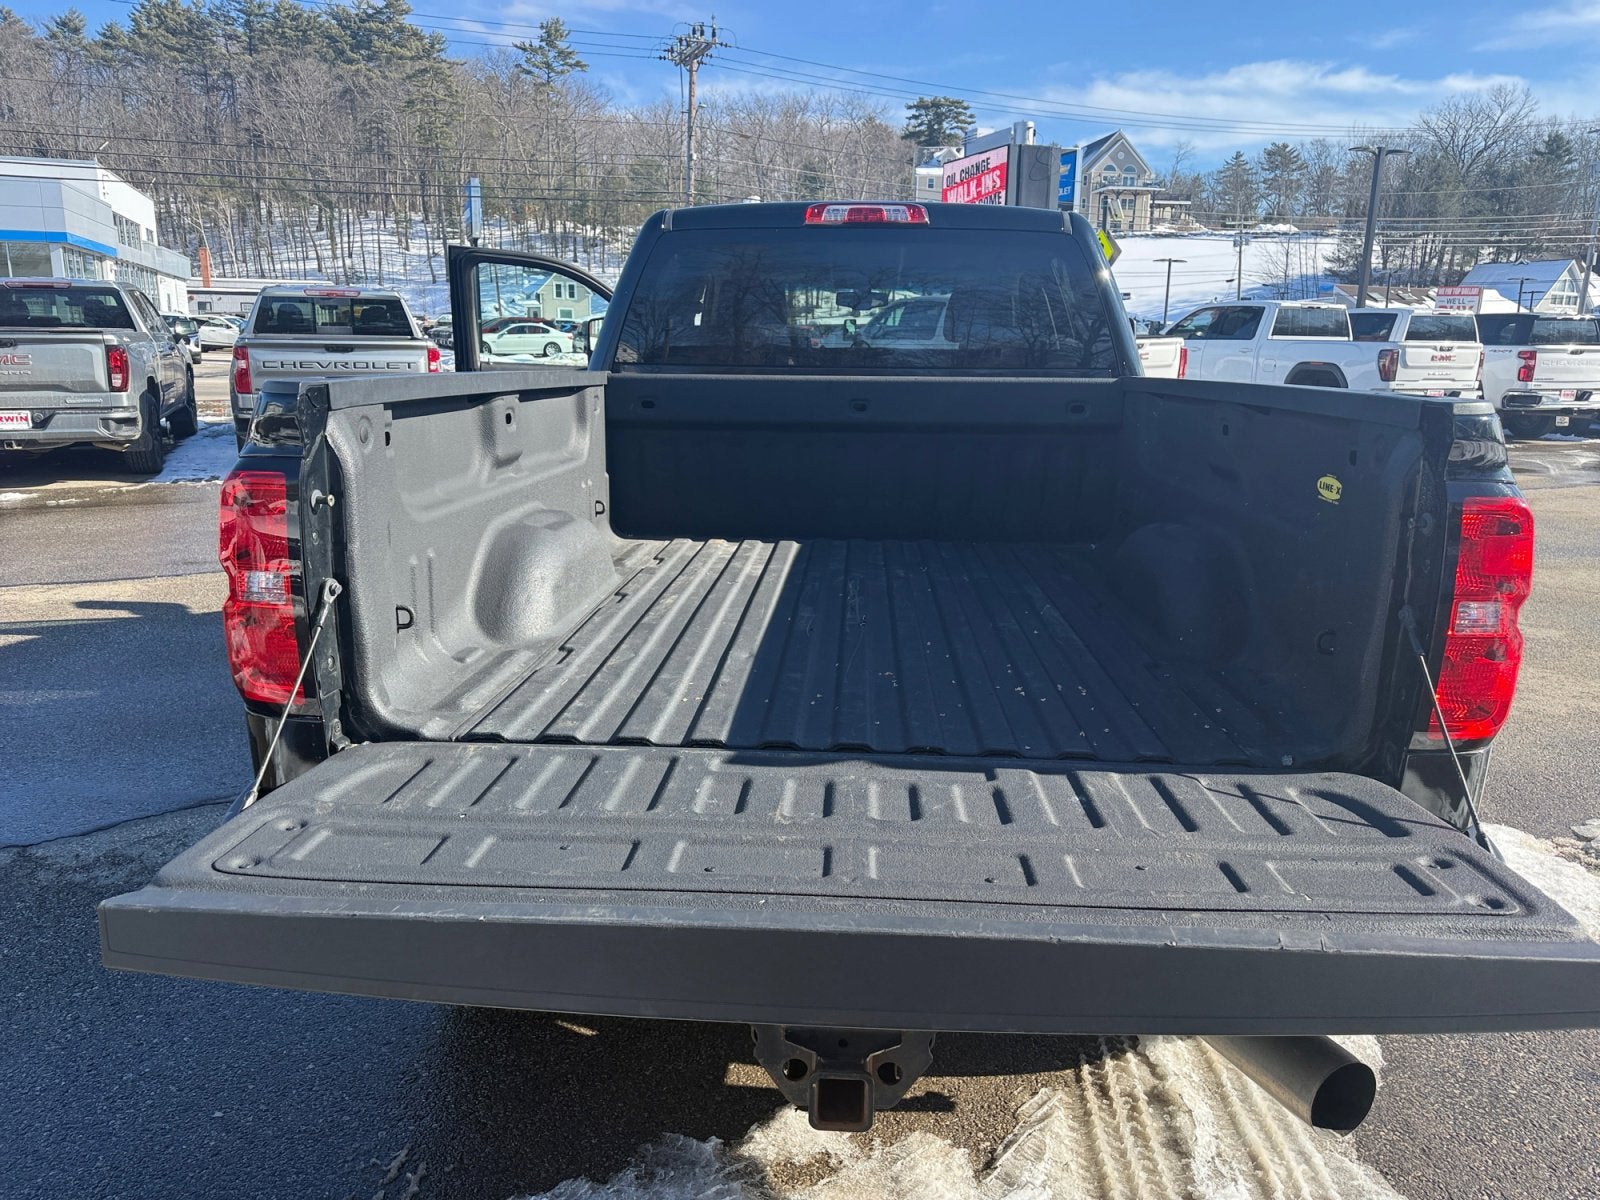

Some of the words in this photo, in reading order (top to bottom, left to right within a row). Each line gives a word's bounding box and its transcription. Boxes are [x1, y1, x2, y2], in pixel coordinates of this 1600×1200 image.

[946, 172, 957, 187] OIL
[960, 157, 990, 182] CHANGE
[947, 170, 1001, 204] WALK-INS
[262, 360, 417, 370] CHEVROLET
